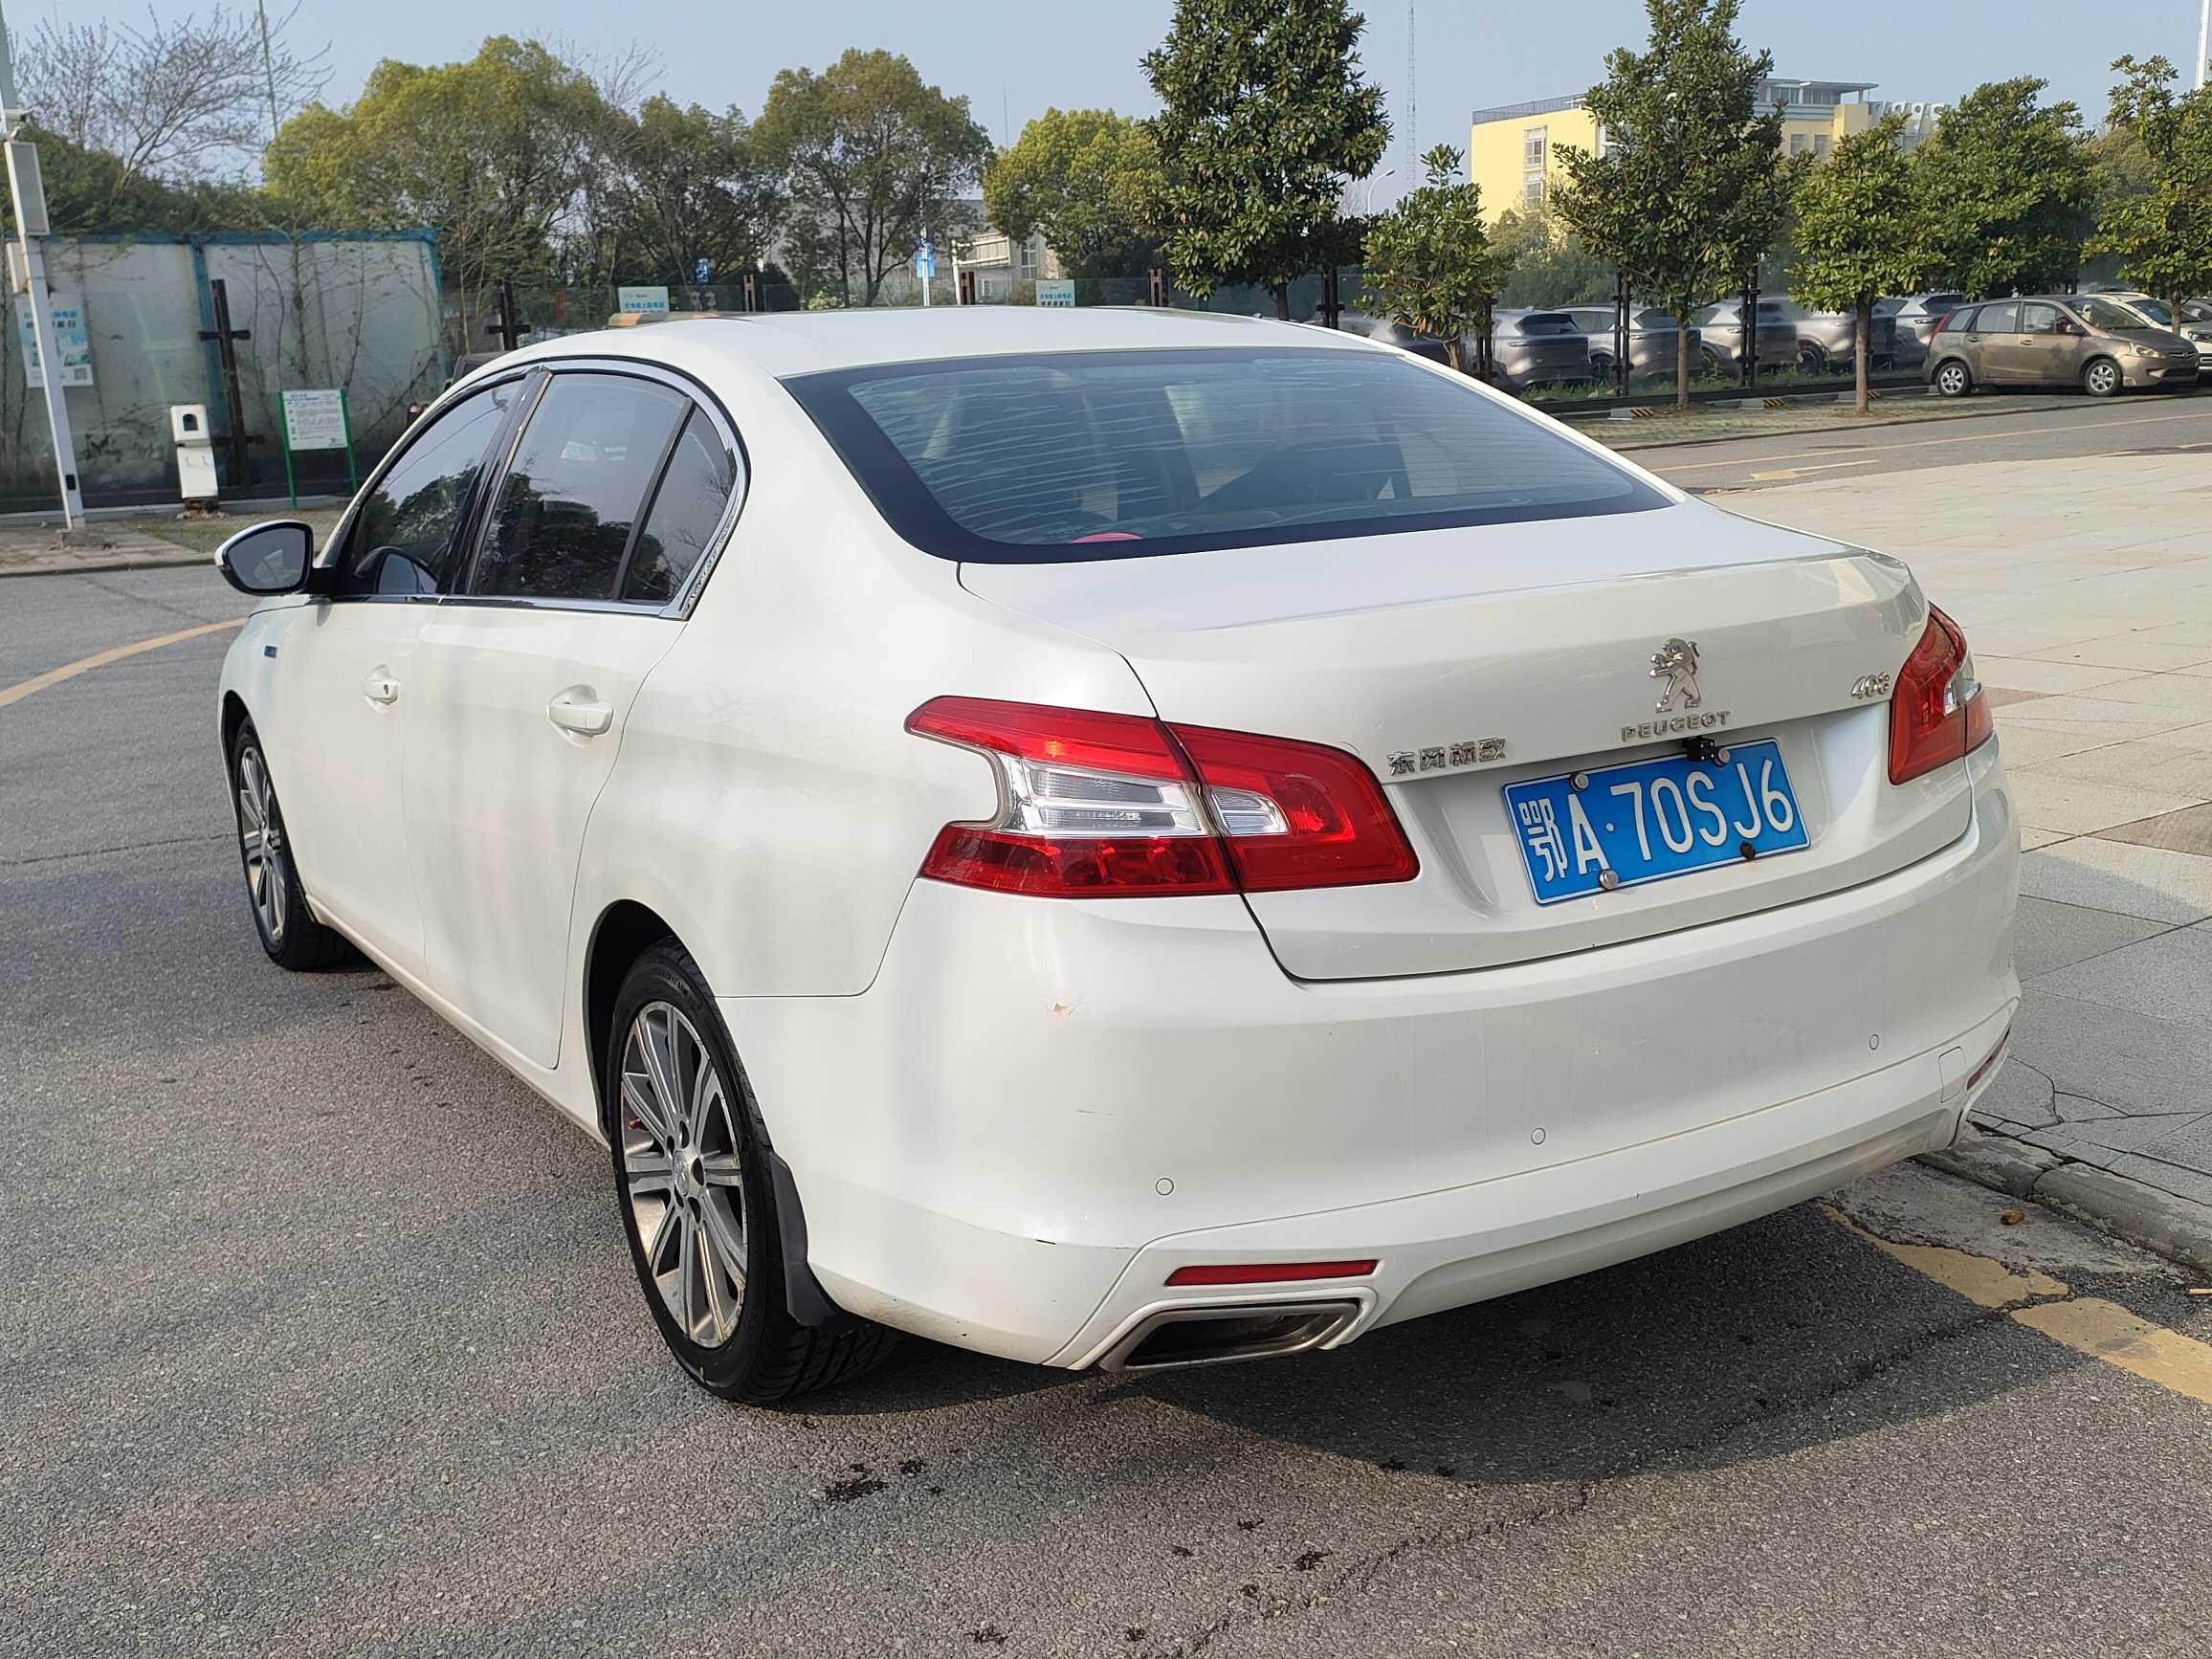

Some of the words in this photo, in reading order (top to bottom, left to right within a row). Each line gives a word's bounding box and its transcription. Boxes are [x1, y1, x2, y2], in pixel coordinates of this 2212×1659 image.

[1851, 672, 1891, 699] 408
[1621, 711, 1731, 742] PEUGEOT
[1386, 736, 1506, 776] 东风标致
